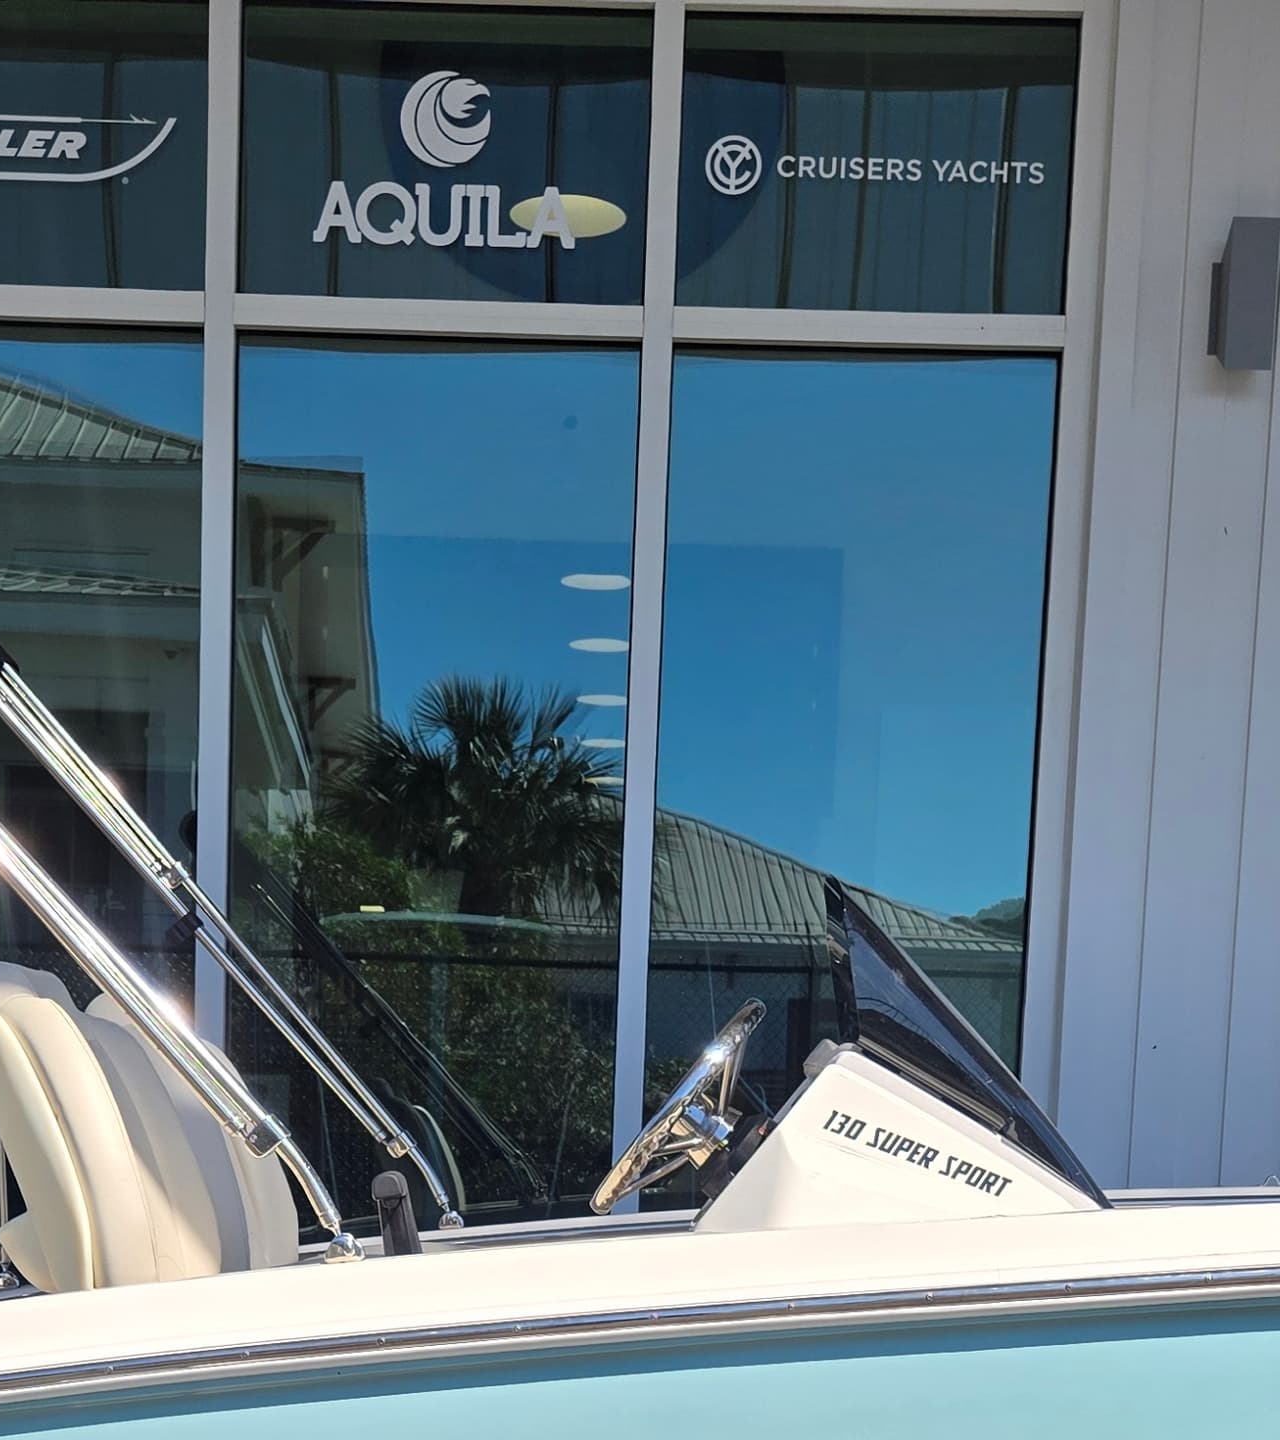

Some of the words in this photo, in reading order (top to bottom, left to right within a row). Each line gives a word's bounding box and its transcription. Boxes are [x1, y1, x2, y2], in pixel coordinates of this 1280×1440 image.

[777, 154, 923, 182] CRUISERS
[932, 158, 1046, 185] YACHTS
[313, 180, 576, 249] AQUILA
[823, 1110, 867, 1140] 130
[866, 1127, 940, 1169] SUPER
[938, 1155, 1013, 1197] SPORT
